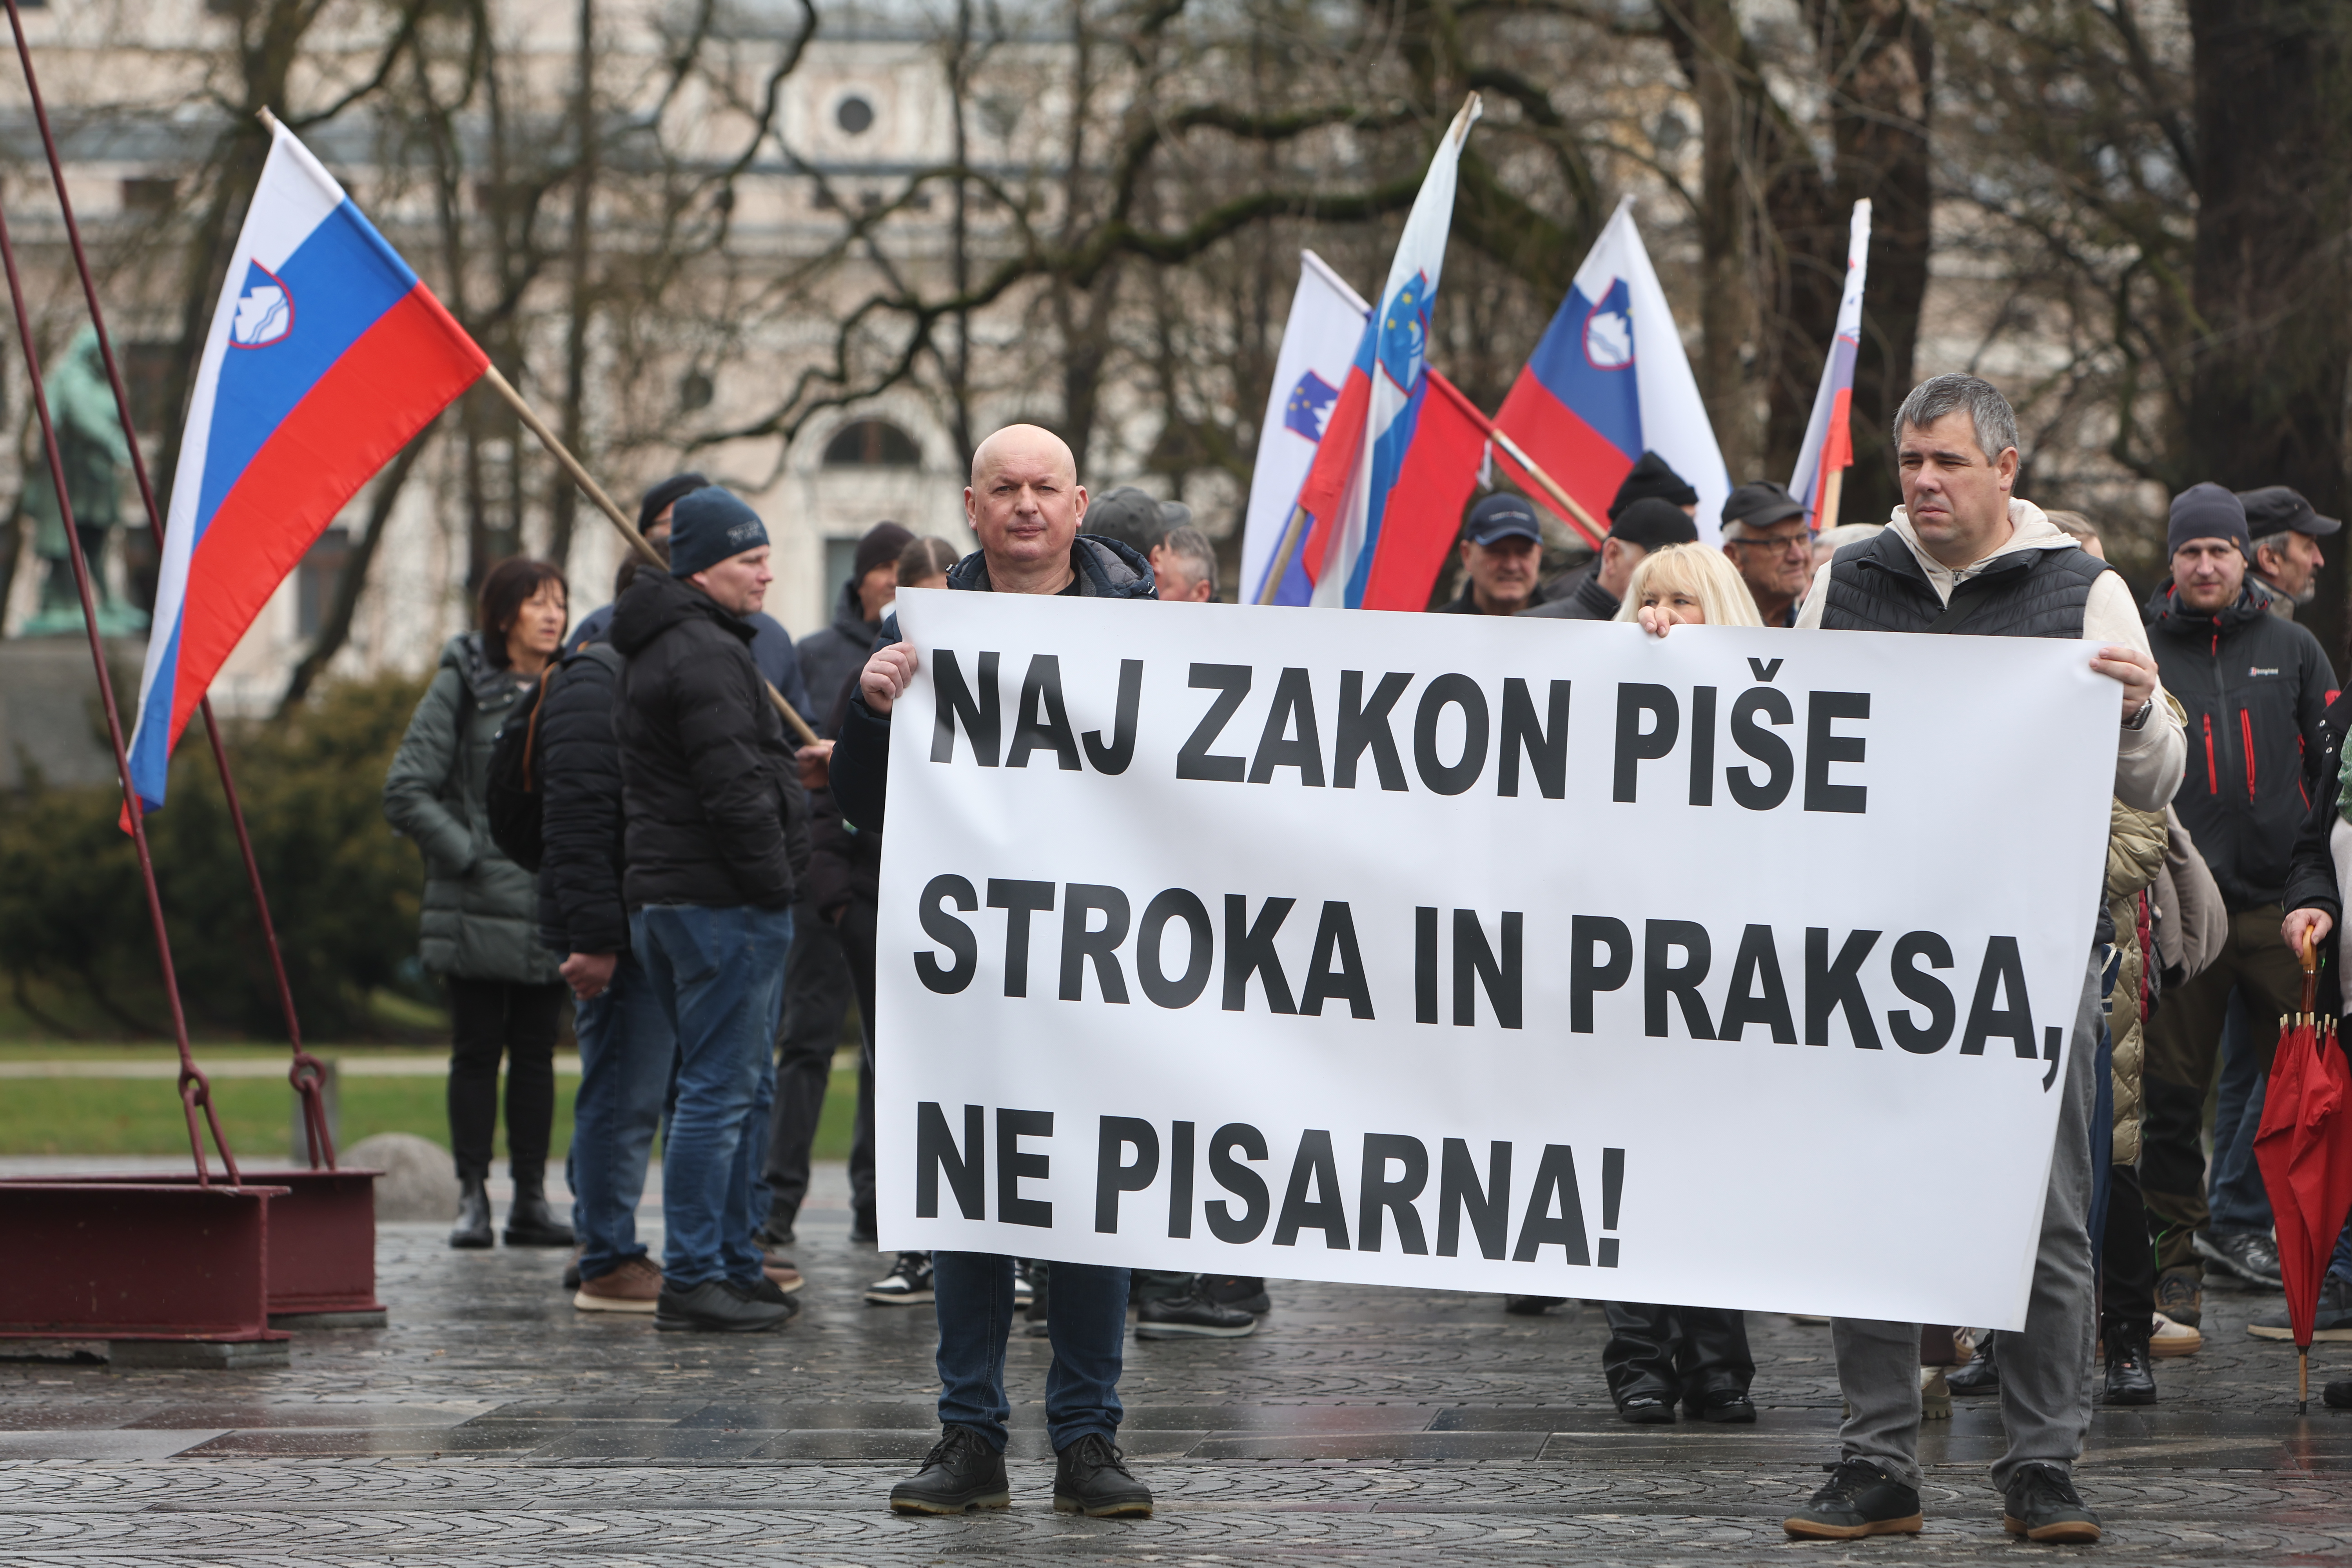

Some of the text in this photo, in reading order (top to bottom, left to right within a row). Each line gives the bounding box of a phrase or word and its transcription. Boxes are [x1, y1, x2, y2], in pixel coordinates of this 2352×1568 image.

[931, 648, 1871, 814] NAJ ZAKON PIŠE
[913, 873, 2063, 1094] STROKA IN PRAKSA,
[915, 1101, 1626, 1269] NE PISARNA!
